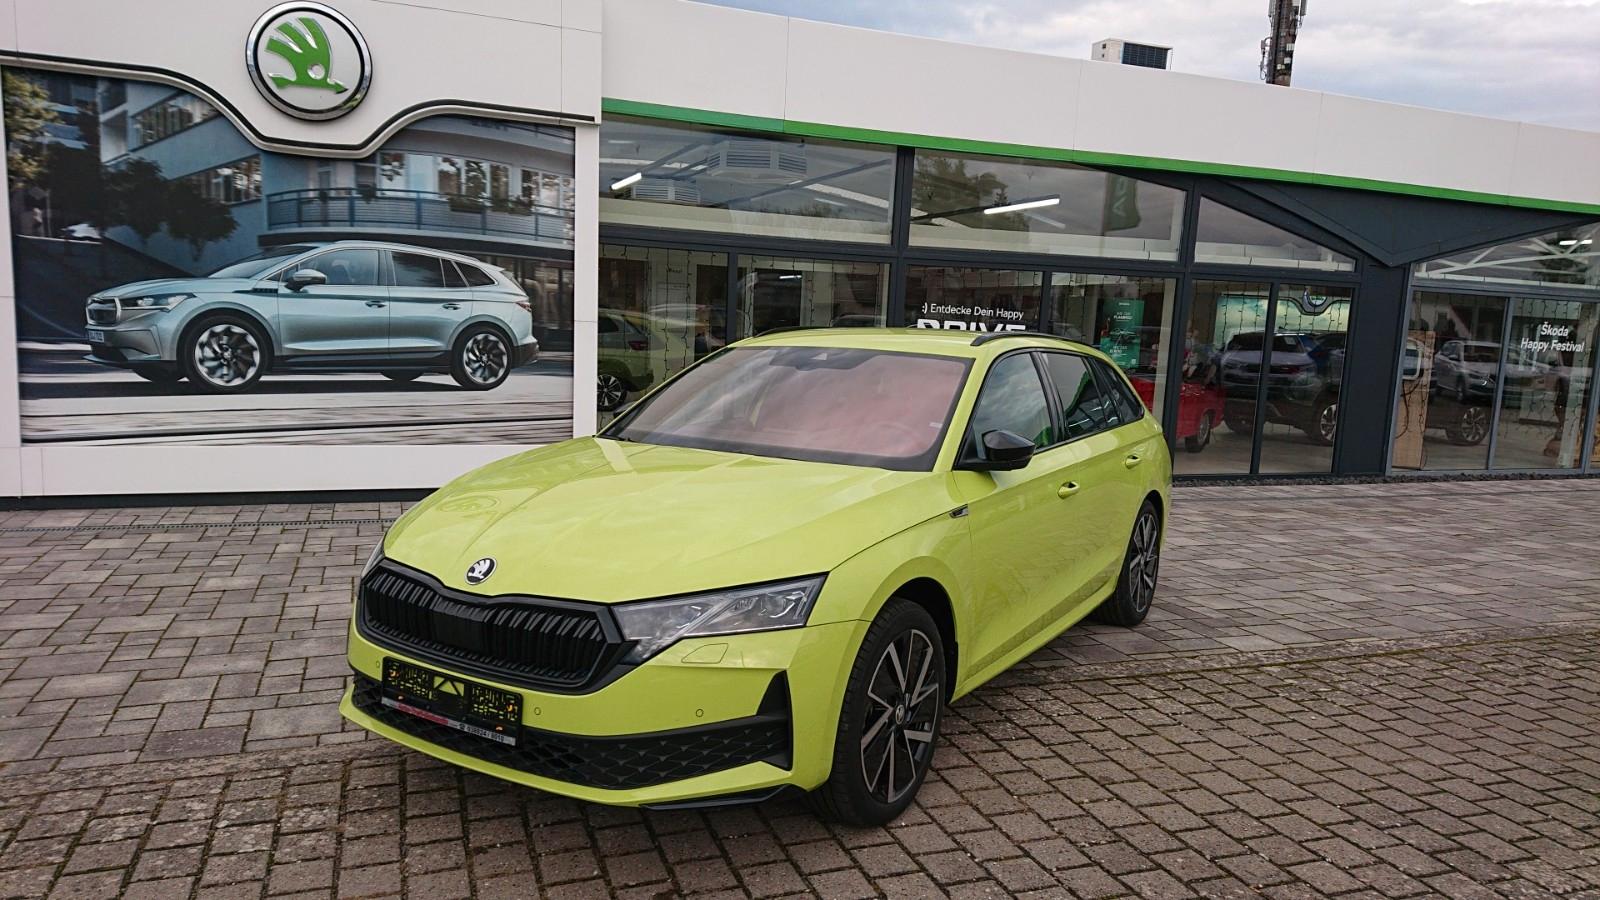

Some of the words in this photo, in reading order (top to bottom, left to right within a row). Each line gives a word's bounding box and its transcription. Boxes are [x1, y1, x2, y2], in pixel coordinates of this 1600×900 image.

[930, 303, 972, 315] Entdecke
[974, 307, 994, 316] Dein
[996, 308, 1024, 320] Happy
[1541, 321, 1569, 337] Škoda
[1521, 337, 1549, 352] Happy
[1551, 339, 1585, 352] Festival
